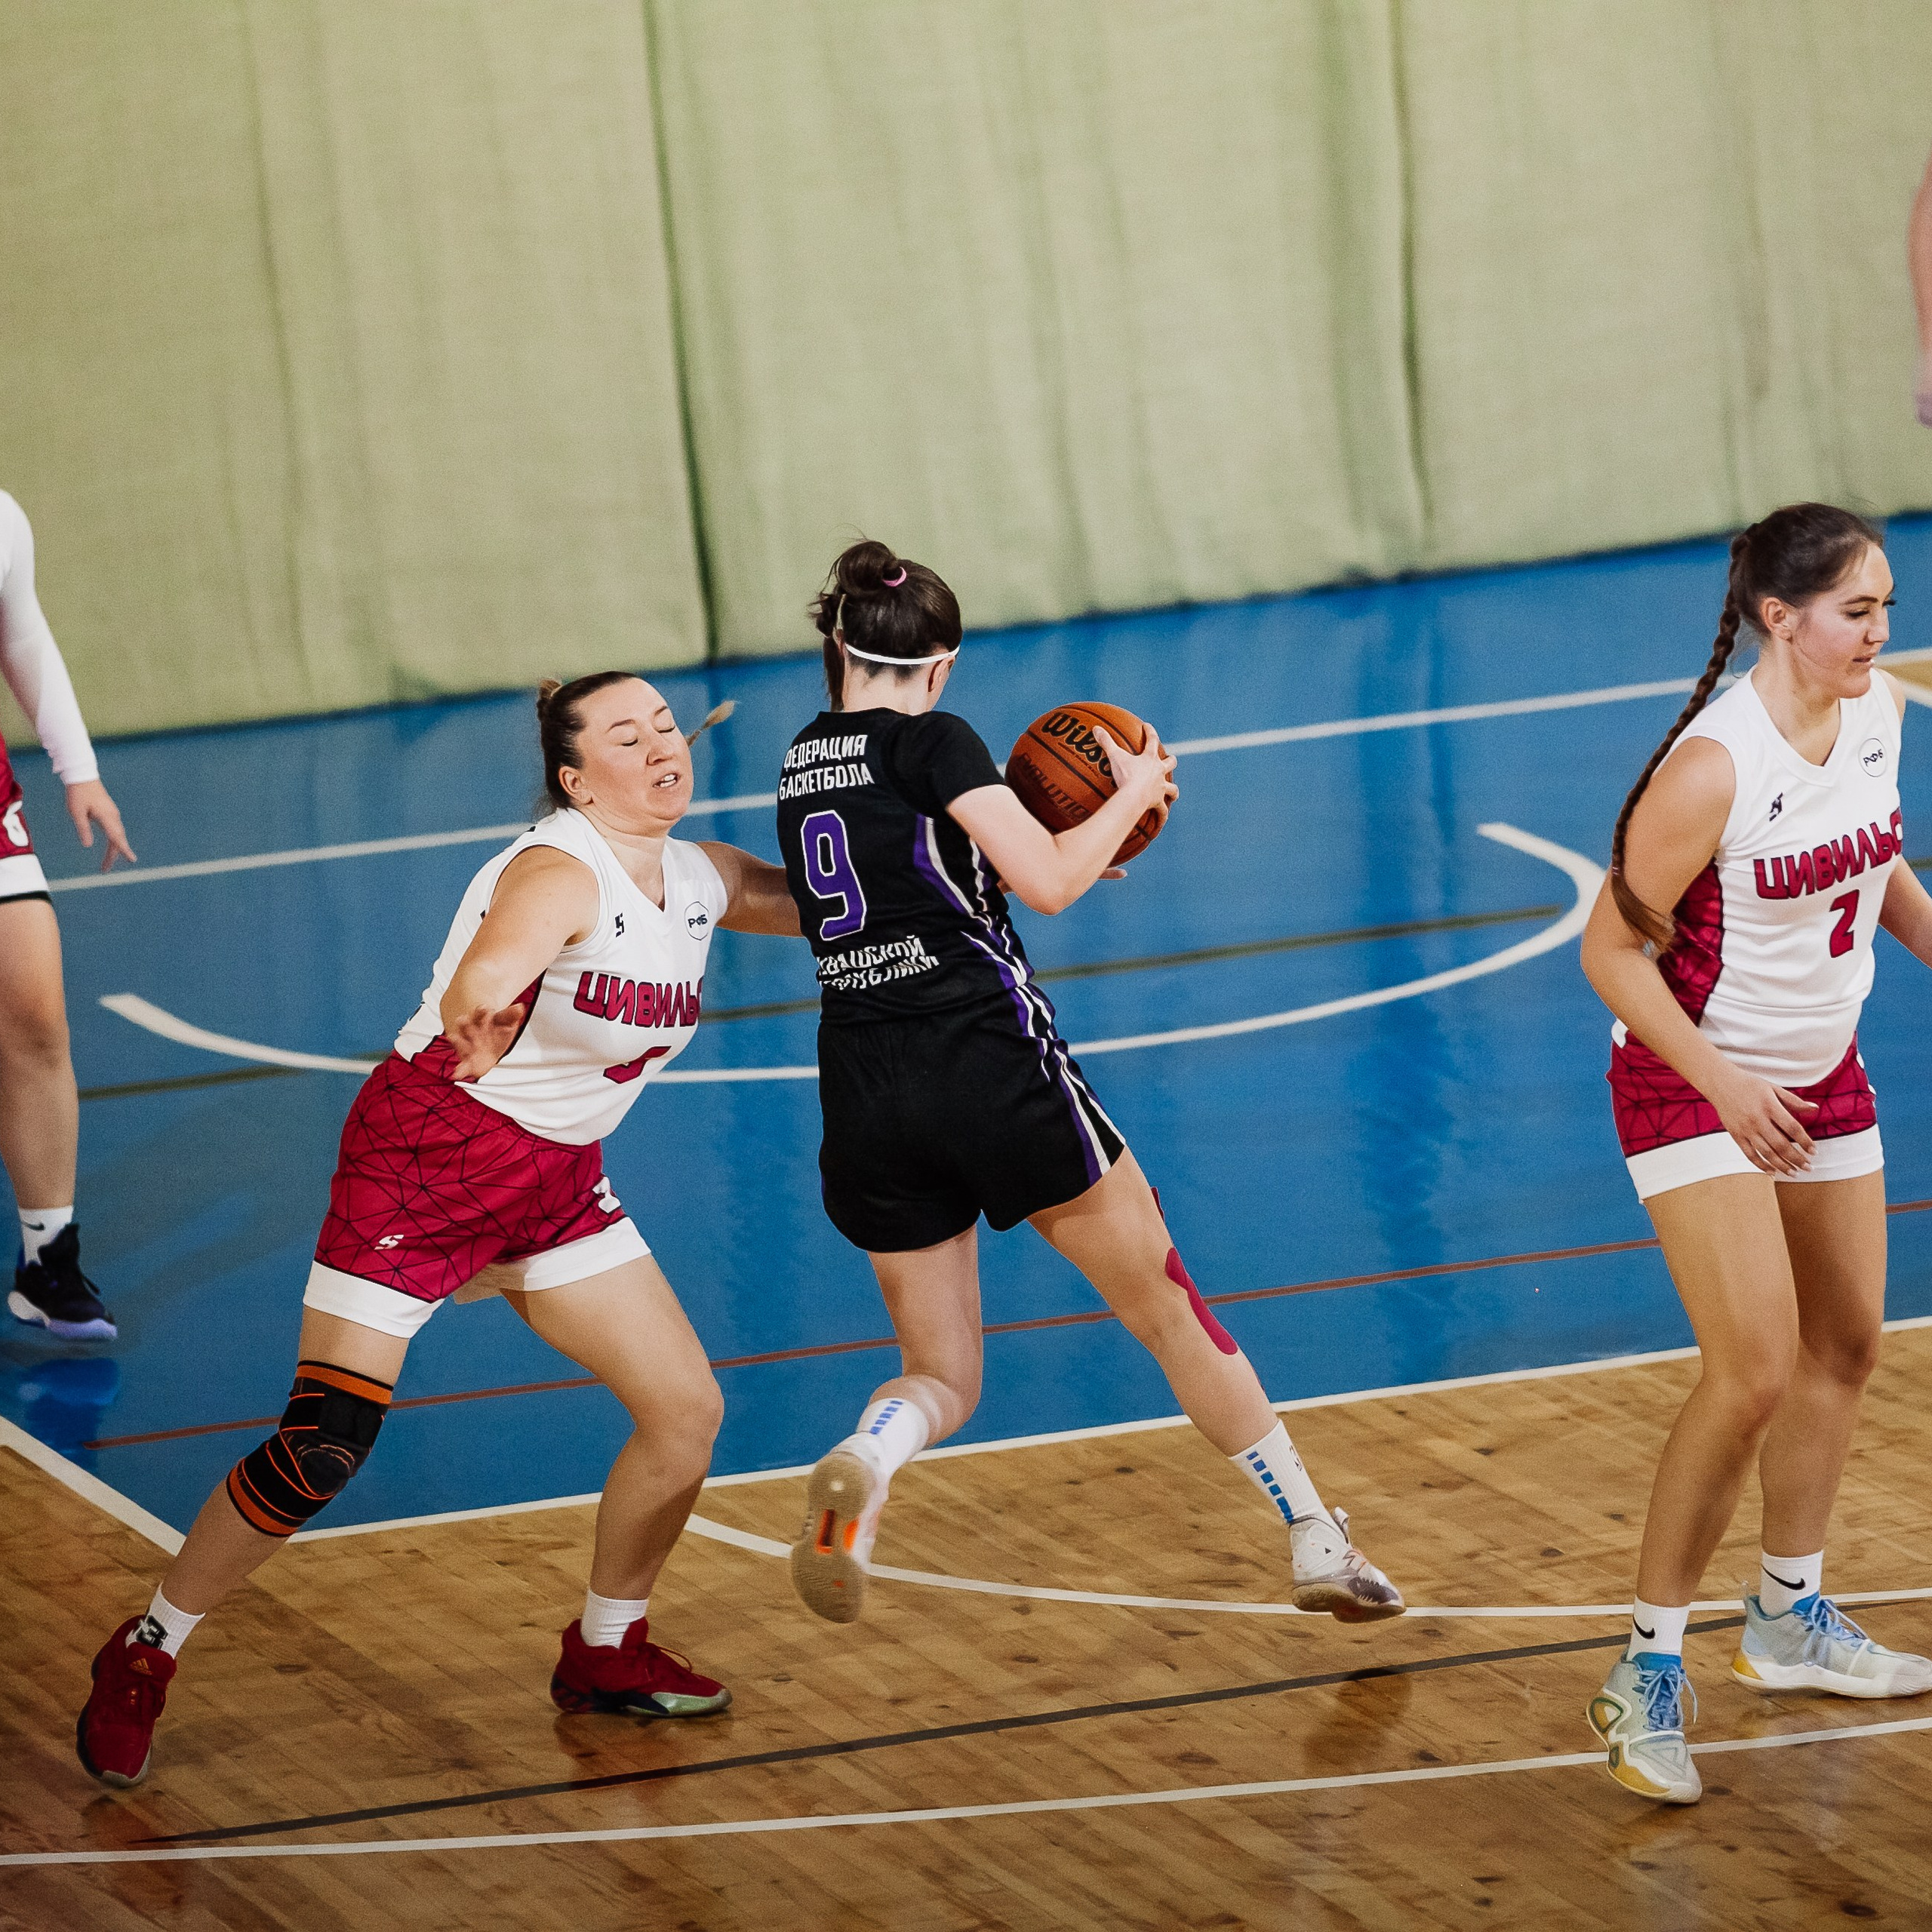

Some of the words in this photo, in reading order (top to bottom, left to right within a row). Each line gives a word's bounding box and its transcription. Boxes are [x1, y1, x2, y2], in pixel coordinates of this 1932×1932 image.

[779, 763, 875, 801] БАСКЕТБОЛА
[783, 734, 868, 771] ФЕДЕРАЦИЯ
[1041, 711, 1119, 789] Wilso
[1018, 752, 1092, 820] EVOLUTIO
[800, 809, 867, 941] 9
[1753, 806, 1903, 900] ЦИВИЛЬС
[1829, 888, 1860, 958] 2
[573, 971, 703, 1029] ЦИВИЛЬ
